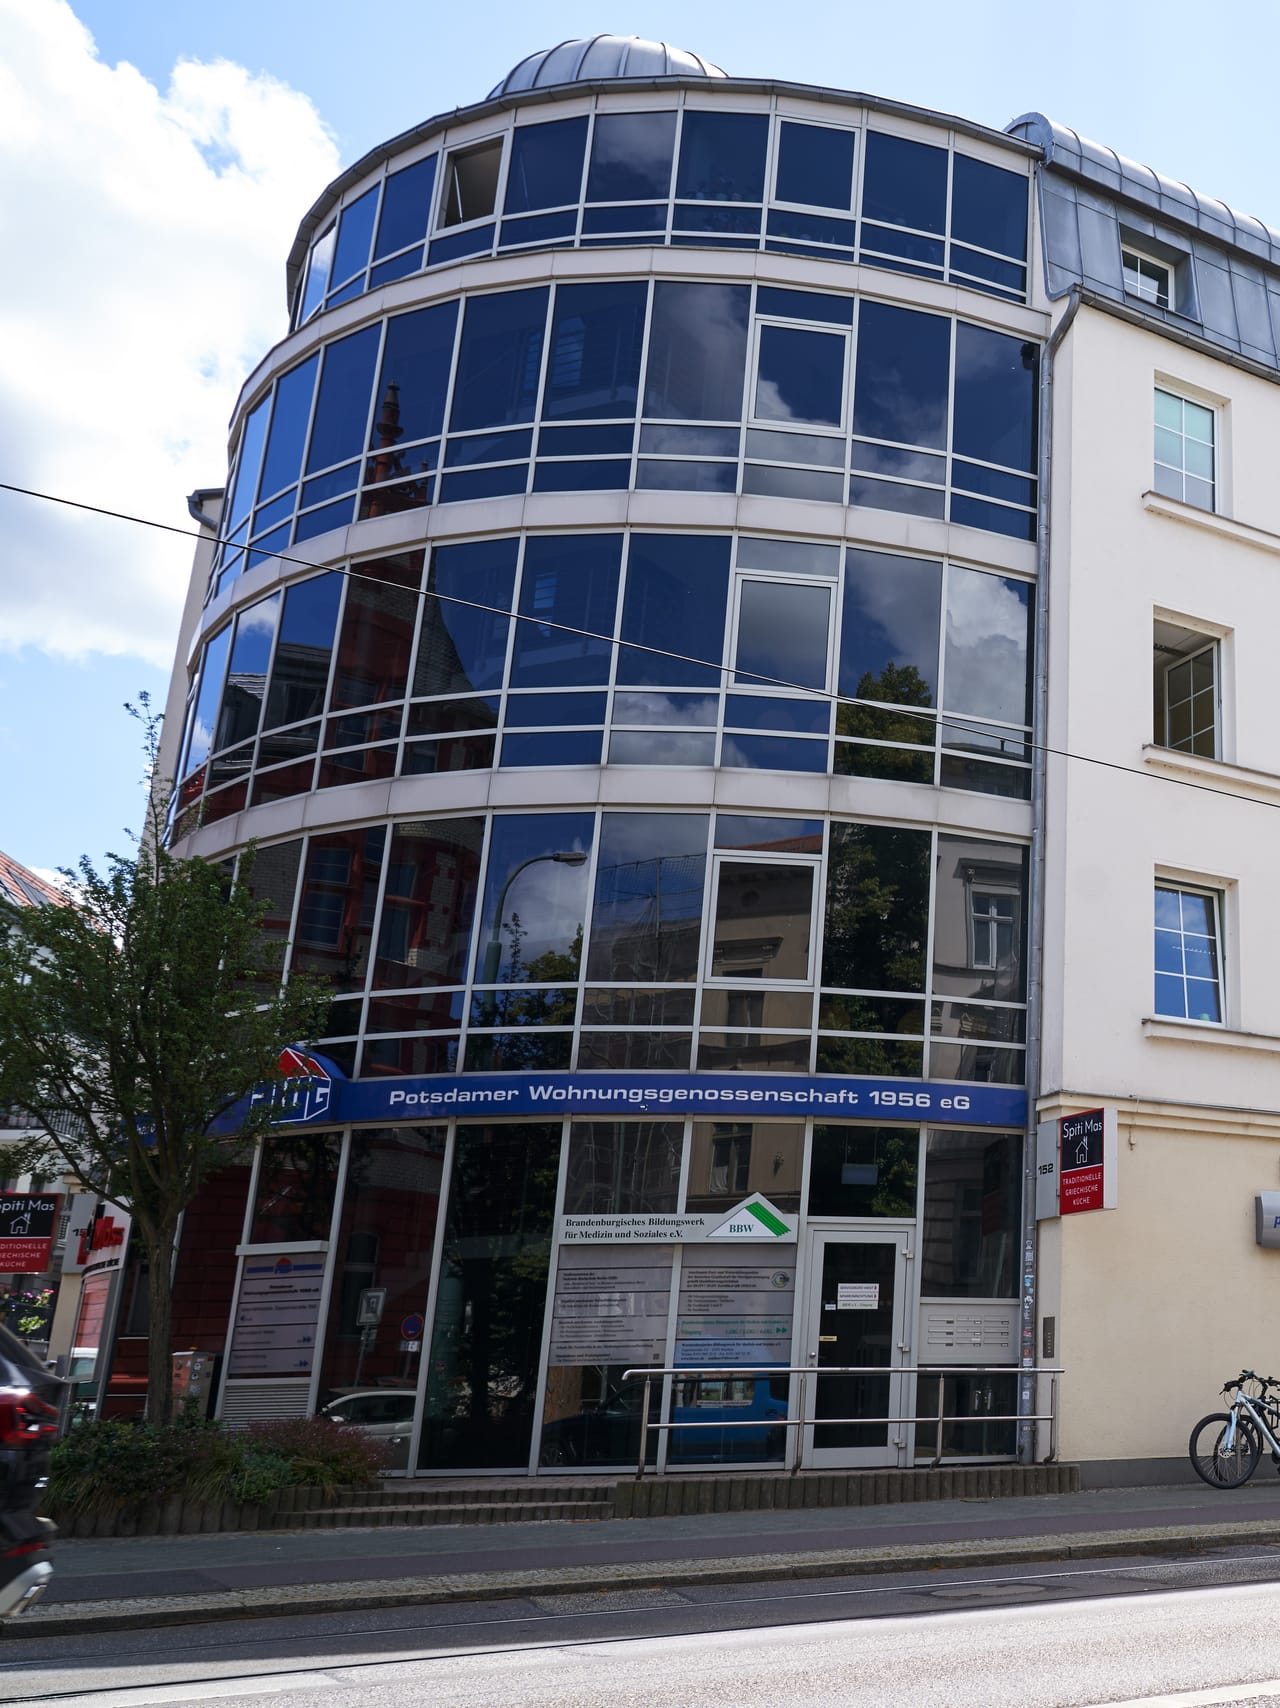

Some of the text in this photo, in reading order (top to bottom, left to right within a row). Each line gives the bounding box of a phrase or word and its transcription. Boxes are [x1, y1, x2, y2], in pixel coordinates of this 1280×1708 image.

[389, 1085, 970, 1110] Potsdamer Wohnungsgenossenschaft 1956 eG
[1063, 1119, 1102, 1140] Spiti Mas
[1038, 1163, 1054, 1175] 152
[1062, 1172, 1102, 1185] TRADITIONELLE
[1065, 1184, 1098, 1196] GRIECHISCHE
[28, 1200, 55, 1211] Mas
[1072, 1196, 1090, 1206] KÜCHE
[565, 1217, 705, 1228] Brandenburgisches Bildungswerk
[729, 1224, 754, 1233] BBW
[564, 1230, 683, 1239] für Medizin und Soziales e.V.
